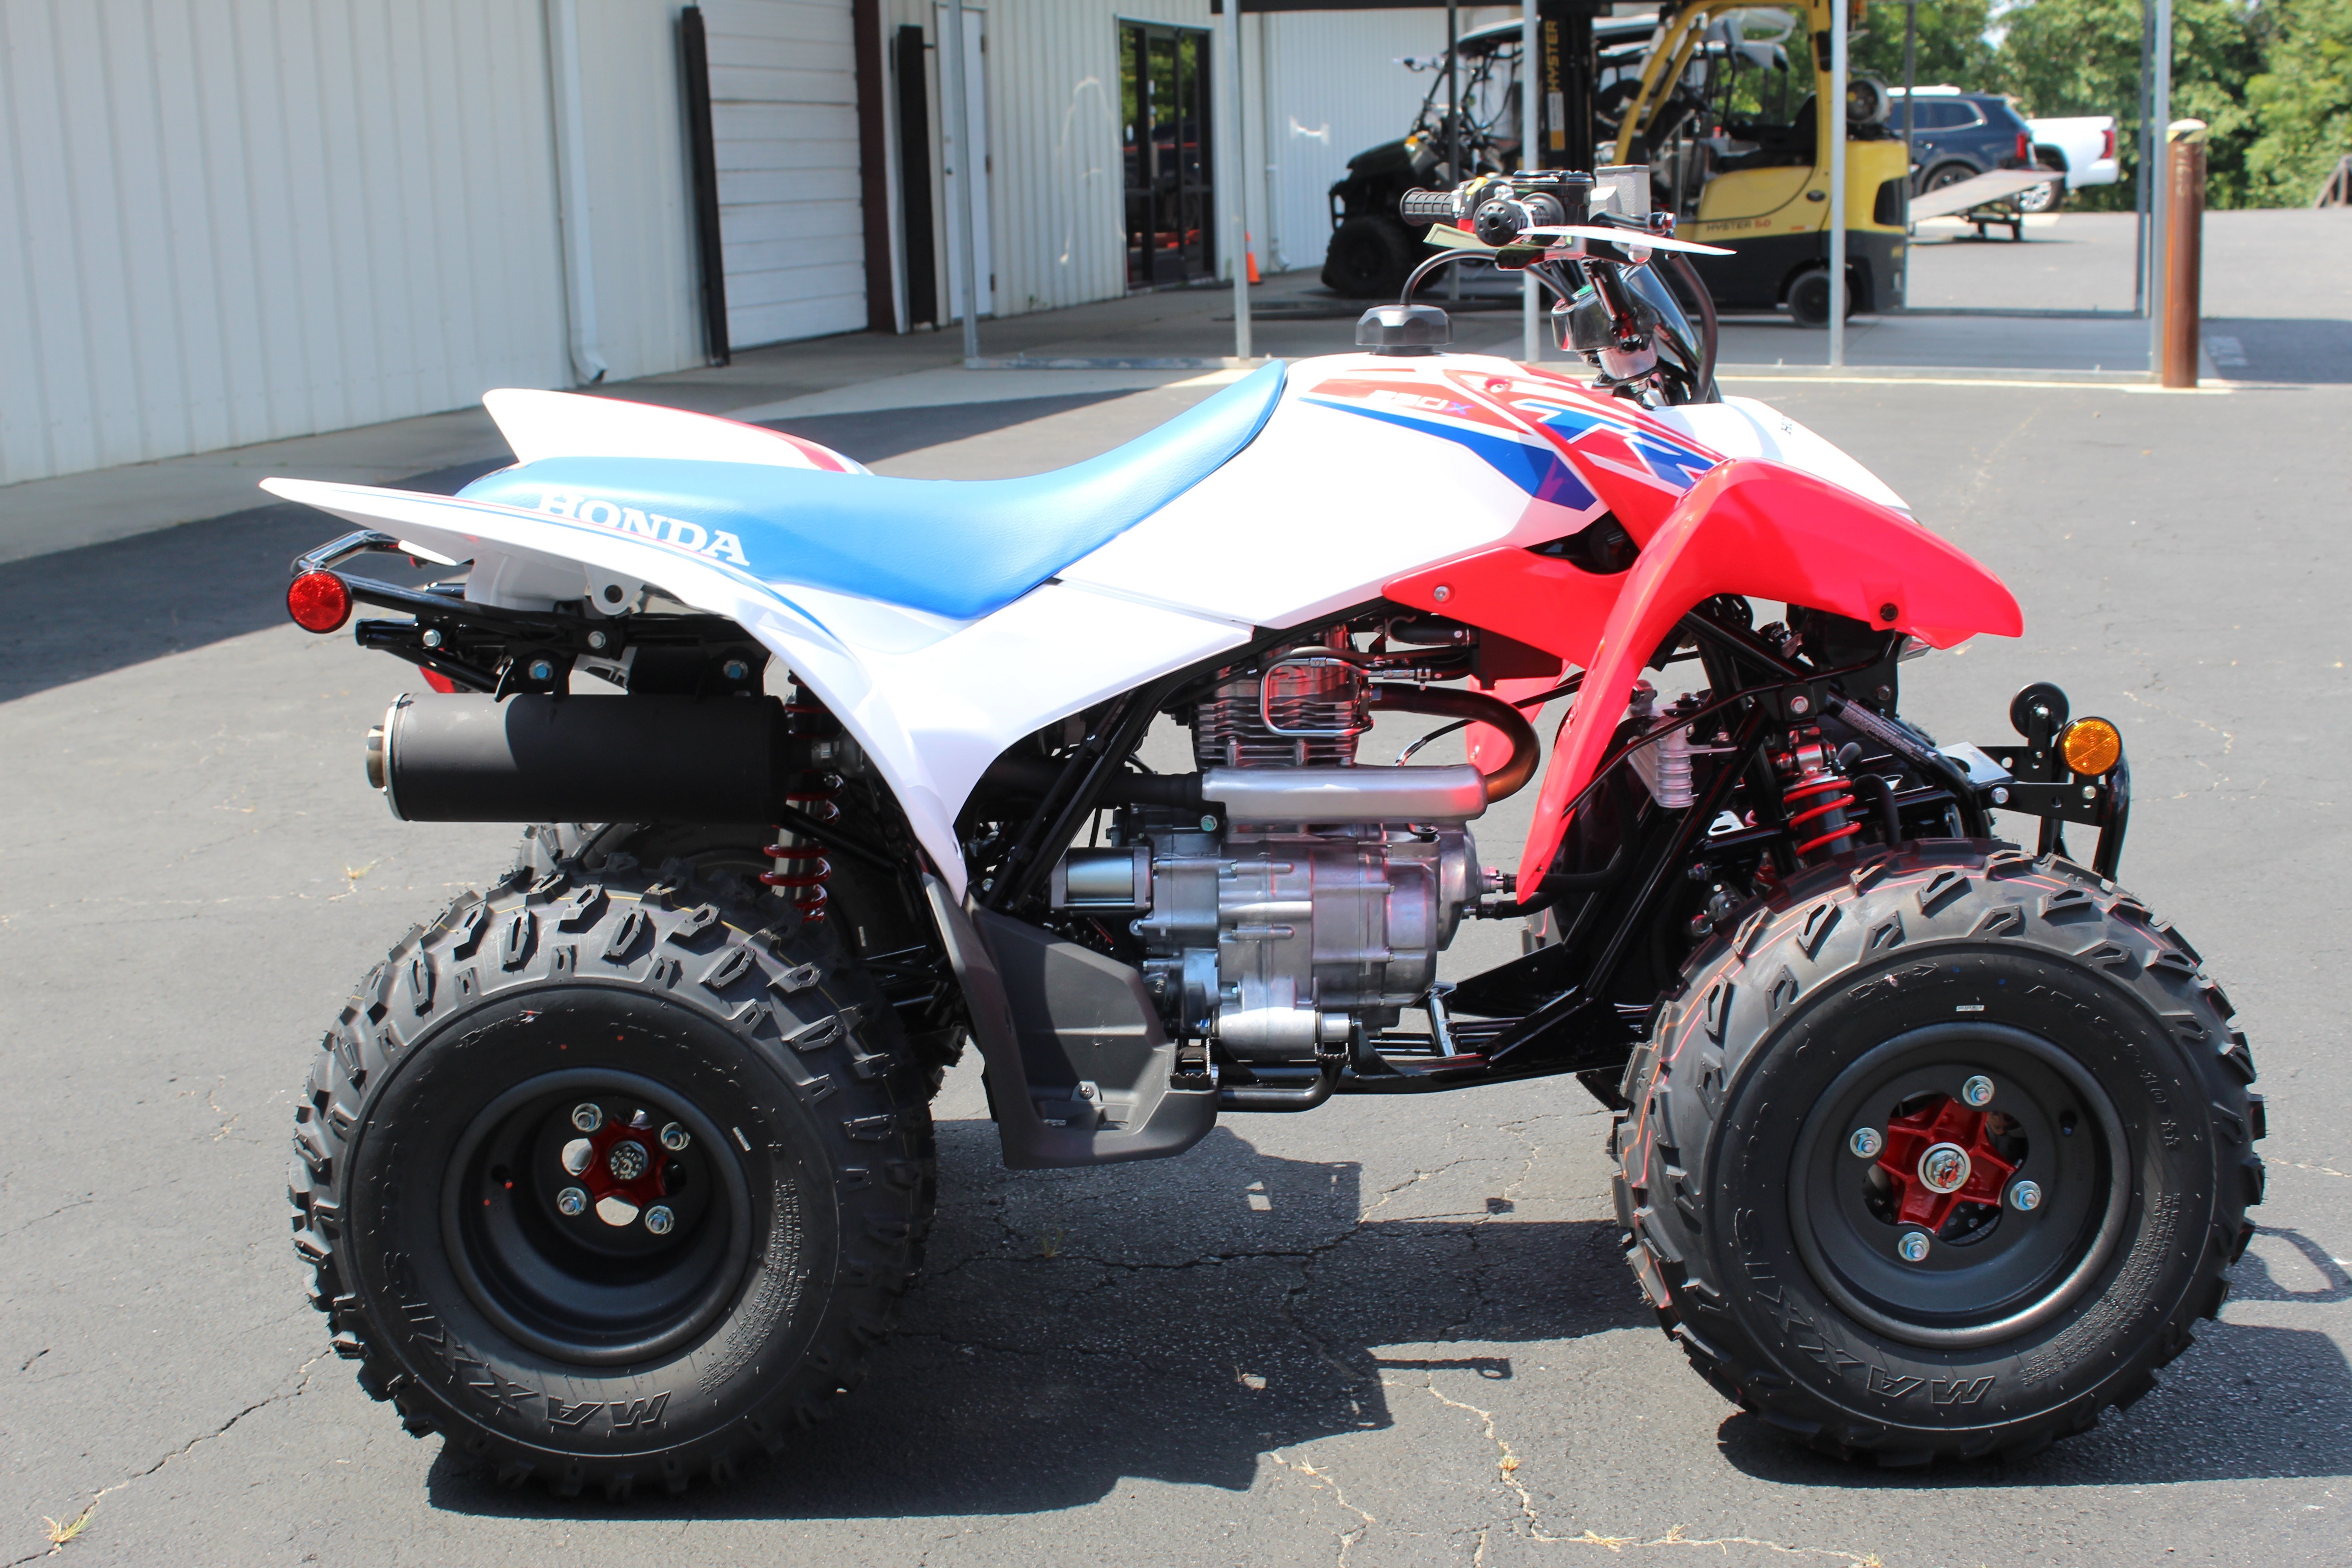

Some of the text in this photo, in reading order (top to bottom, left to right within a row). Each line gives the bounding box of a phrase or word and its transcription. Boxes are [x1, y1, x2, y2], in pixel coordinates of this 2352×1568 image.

[1545, 20, 1561, 93] HYSTER
[1706, 220, 1752, 232] HYSTER
[537, 492, 751, 567] HONDA
[383, 1250, 671, 1429] MAXXIS
[1734, 1206, 1995, 1405] MAXXIS
[2118, 1294, 2155, 1336] WARNING
